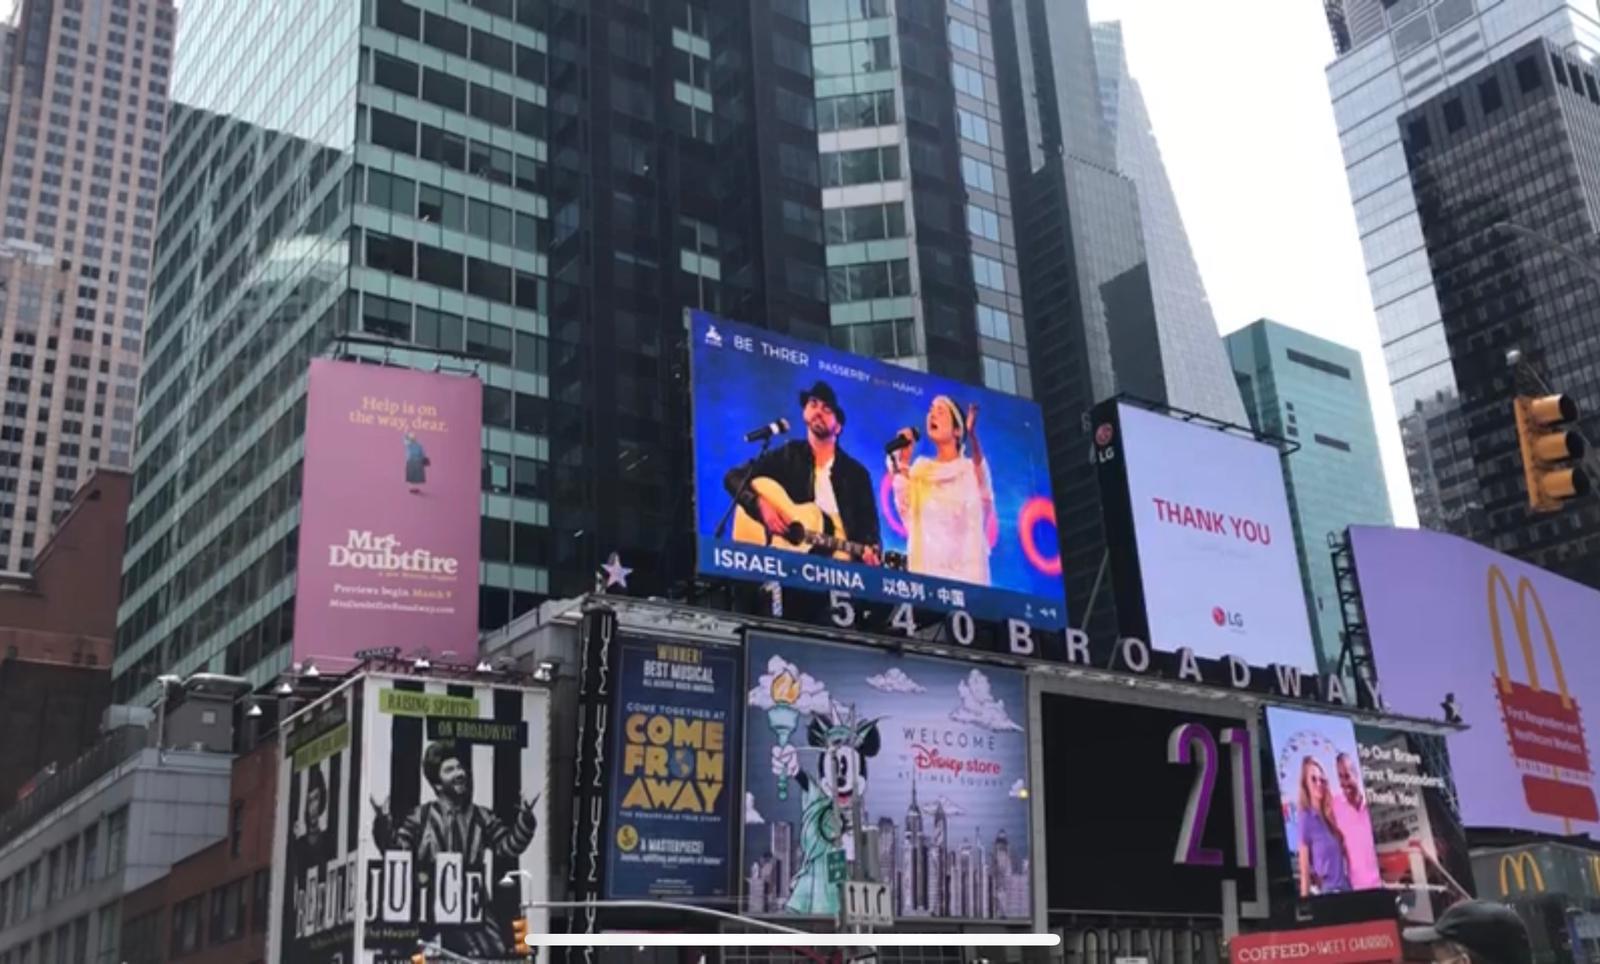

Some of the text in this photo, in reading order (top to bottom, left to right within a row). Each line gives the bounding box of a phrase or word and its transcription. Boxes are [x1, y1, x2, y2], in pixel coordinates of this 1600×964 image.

[733, 335, 753, 352] BE
[363, 396, 437, 416] Help is on
[349, 410, 448, 432] the way, dear.
[1099, 447, 1115, 463] LG
[1153, 498, 1271, 546] THANK YOU
[347, 529, 401, 551] Mrs.
[328, 545, 458, 574] Doubtfire
[714, 547, 865, 590] ISRAEL CHINA
[882, 578, 926, 601] 以色列
[1228, 612, 1243, 627] LG
[643, 660, 714, 684] BEST MUSICAL
[1009, 618, 1380, 710] BROADWAY
[388, 693, 473, 717] RAISING SPIRITS
[626, 702, 726, 719] COME TOGETHER AT
[625, 714, 724, 750] COME
[903, 727, 995, 751] WELCOME
[624, 744, 724, 781] FROM
[911, 744, 1001, 778] Disney store
[621, 777, 723, 813] AWAY
[1167, 721, 1258, 868] 21
[363, 851, 483, 923] JUICE
